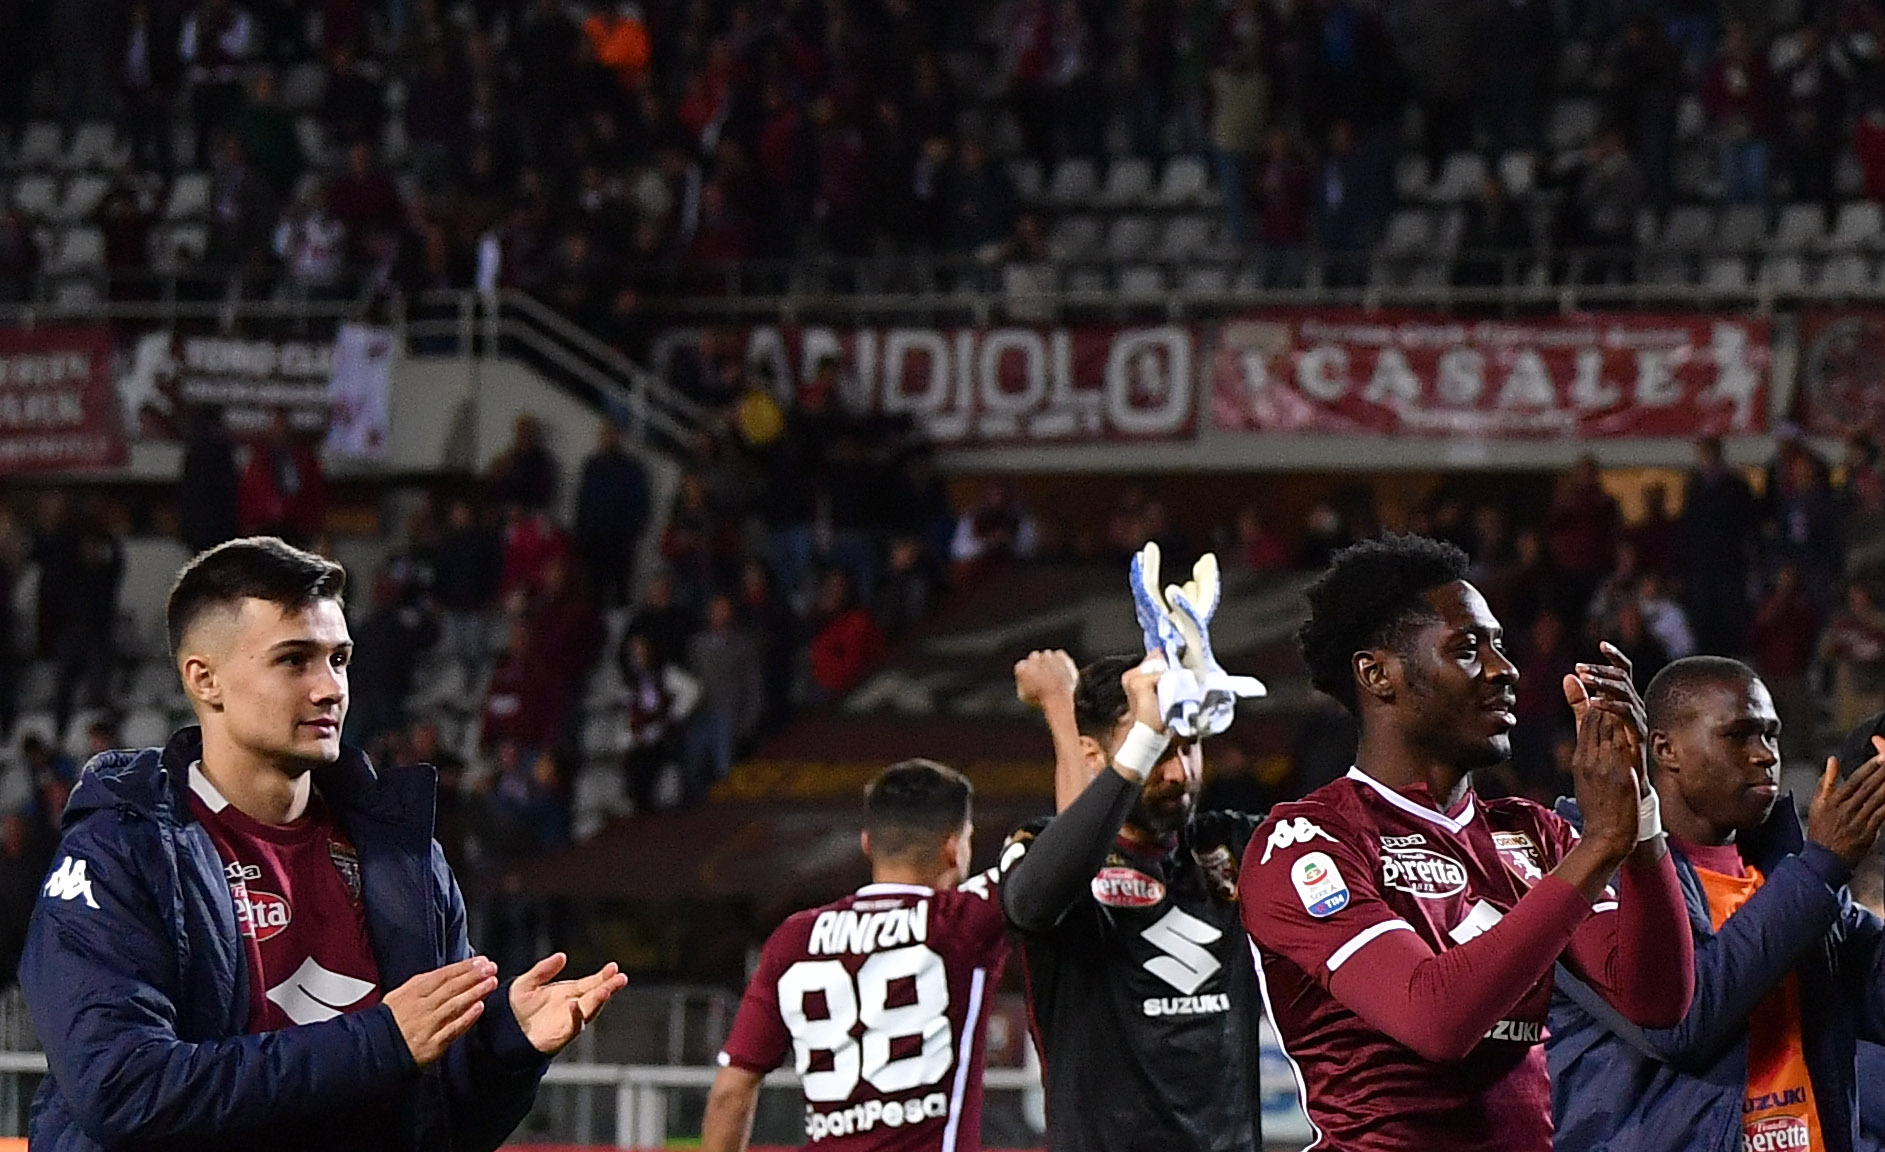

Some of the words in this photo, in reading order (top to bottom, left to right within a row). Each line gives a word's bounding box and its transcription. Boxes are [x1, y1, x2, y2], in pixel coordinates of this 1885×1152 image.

[1299, 344, 1681, 409] CASALE
[1324, 893, 1345, 909] TIM
[778, 944, 953, 1101] 88
[1142, 993, 1231, 1016] SUZUKI
